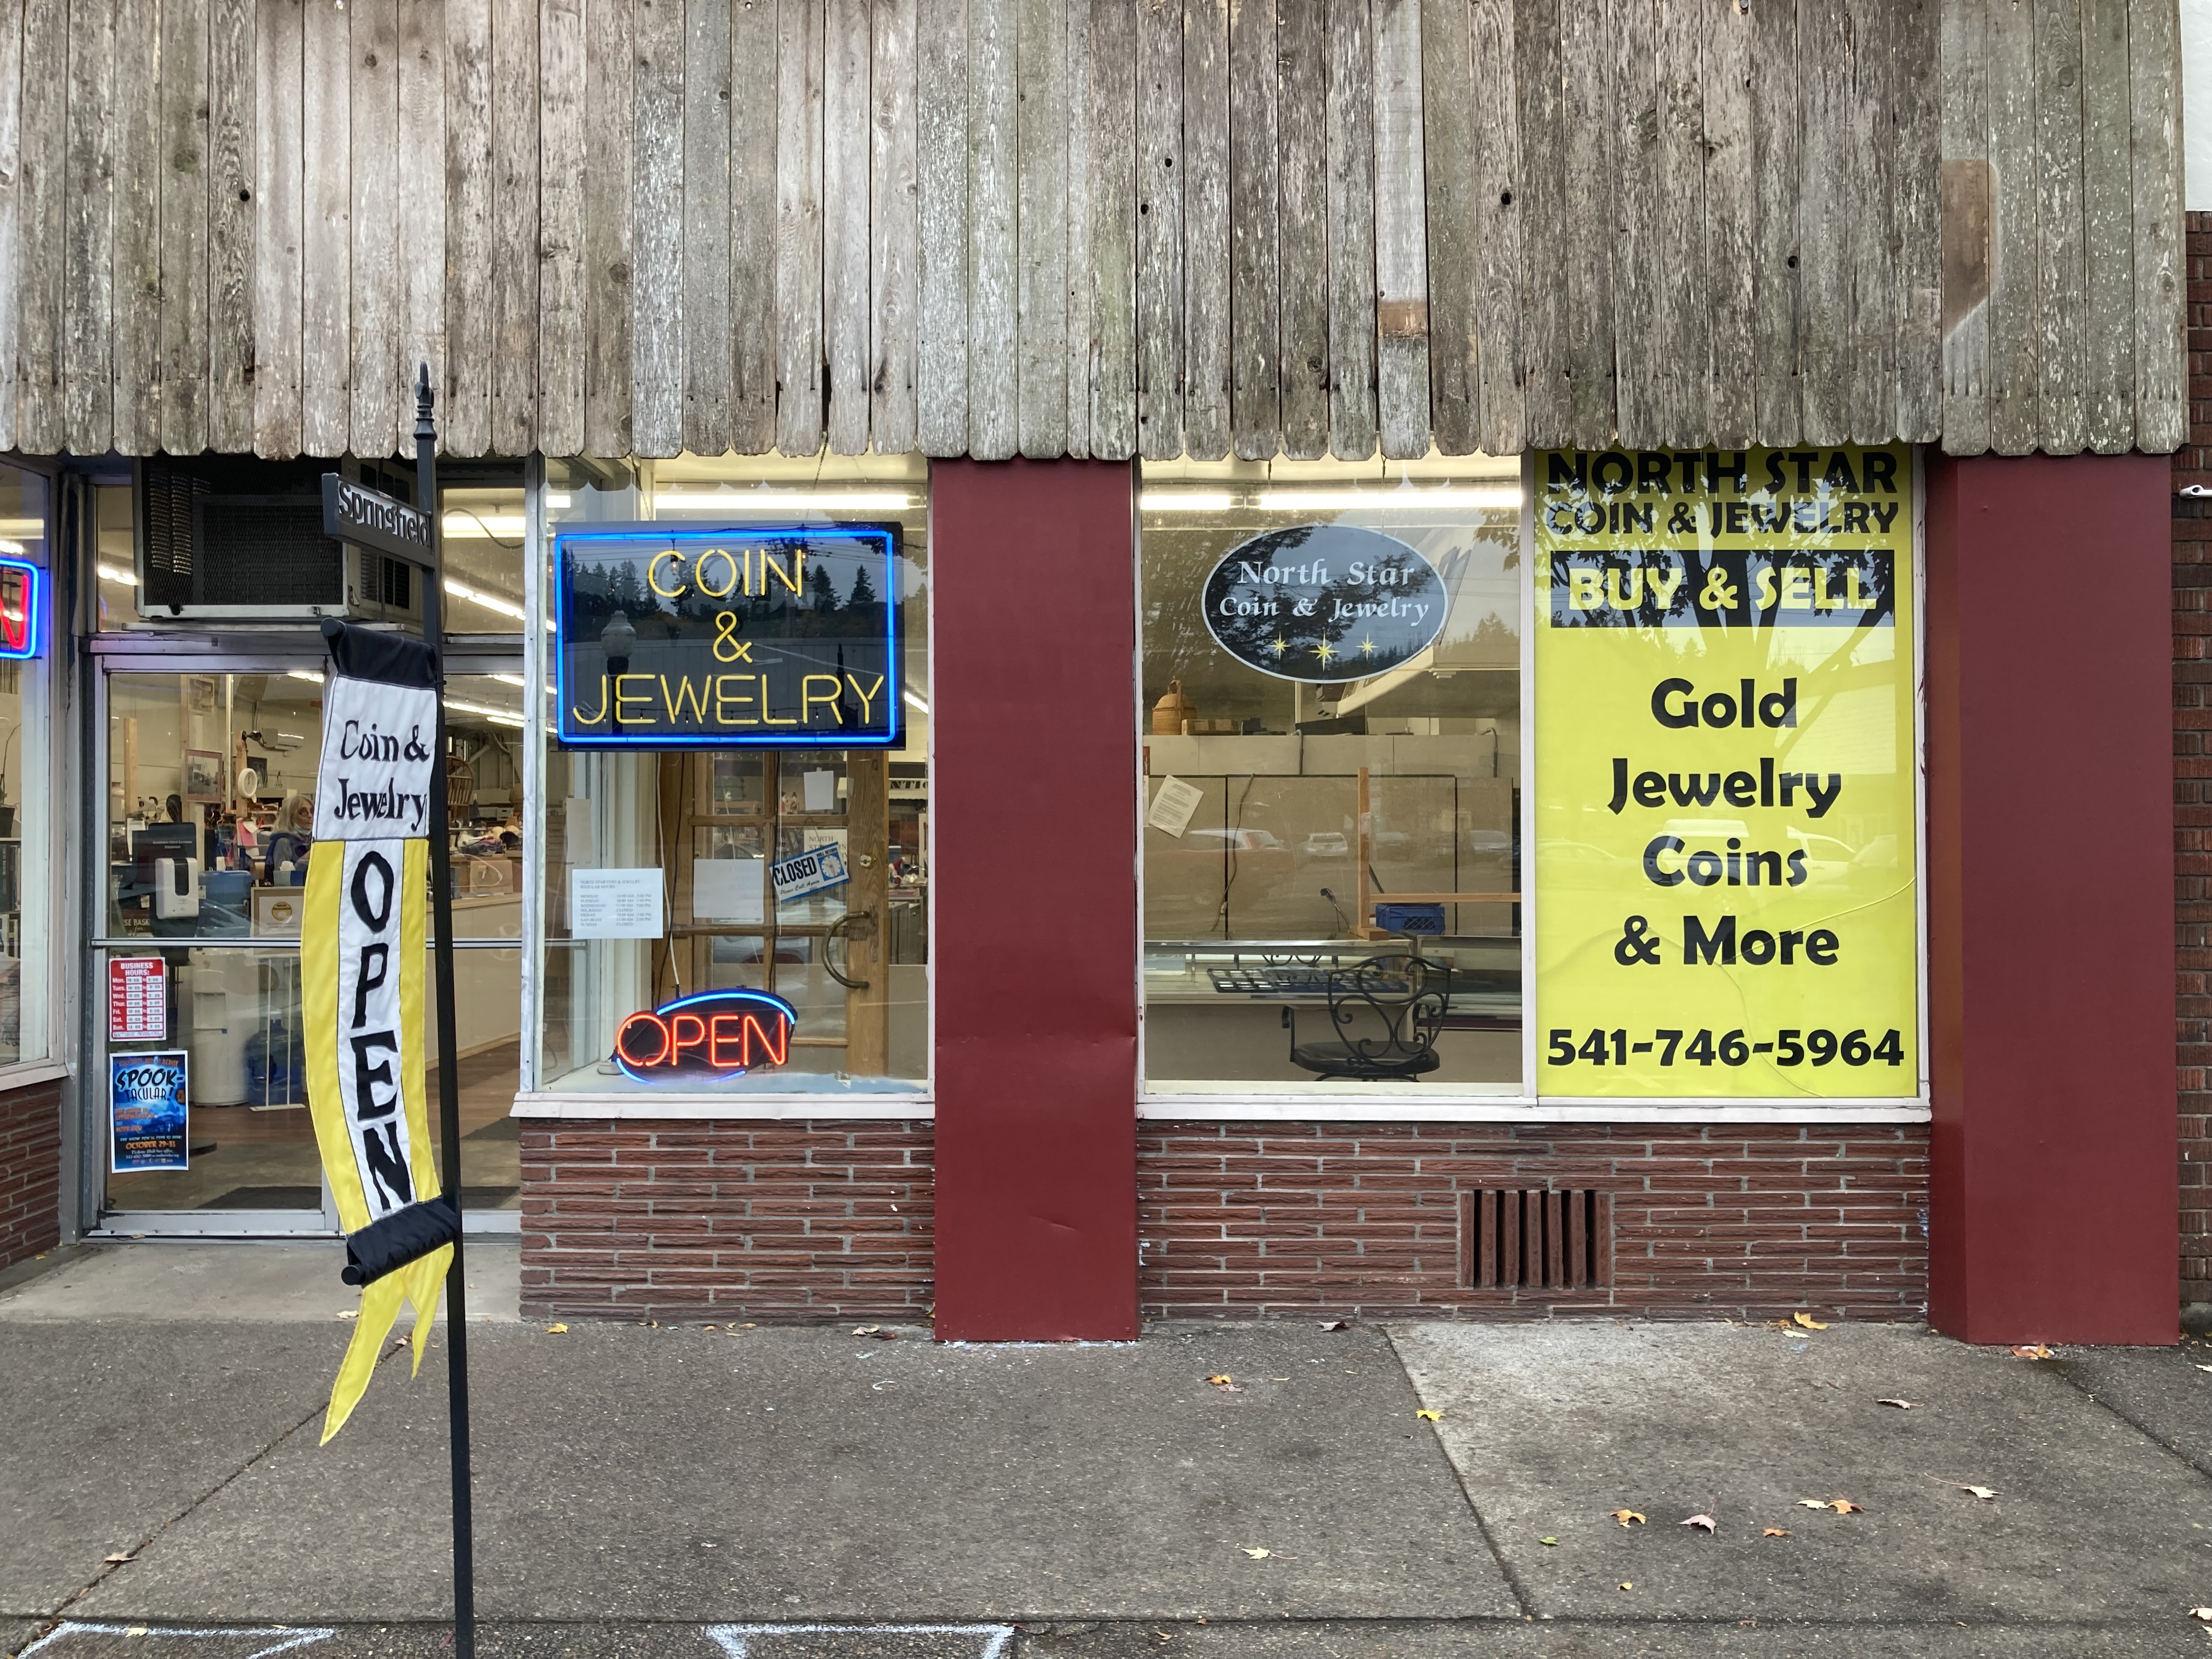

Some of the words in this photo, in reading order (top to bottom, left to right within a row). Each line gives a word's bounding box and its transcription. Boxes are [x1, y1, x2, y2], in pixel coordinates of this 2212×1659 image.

[1548, 451, 1746, 494] NORTH
[1765, 451, 1898, 494] STAR
[339, 482, 432, 547] Springfield
[1545, 502, 1653, 534] COIN
[1667, 502, 1698, 534] &
[1711, 502, 1899, 538] JEWELRY
[647, 549, 803, 597] COIN
[1237, 558, 1331, 585] North
[1347, 561, 1416, 586] Star
[1568, 568, 1683, 610] BUY
[1700, 567, 1738, 610] &
[1756, 567, 1877, 610] SELL
[1220, 596, 1278, 617] Coin
[1293, 598, 1317, 617] &
[1329, 596, 1429, 627] Jewelry
[713, 611, 753, 663] &
[573, 674, 884, 724] JEWELRY
[1651, 678, 1798, 729] Gold
[341, 720, 399, 762] Coin
[404, 724, 431, 763] &
[334, 777, 427, 832] Jewelry
[1607, 758, 1842, 819] Jewelry
[772, 856, 817, 887] CLOSED
[1643, 836, 1808, 887] Coins
[795, 883, 805, 891] Call
[1614, 916, 1661, 966] &
[1684, 916, 1839, 966] More
[349, 850, 413, 1211] OPEN
[617, 1013, 786, 1067] OPEN
[1548, 1029, 1904, 1066] 541-746-5964
[117, 1068, 184, 1090] SPOOK-
[124, 1087, 174, 1102] TACULAR!
[126, 1141, 157, 1149] OCTOBER
